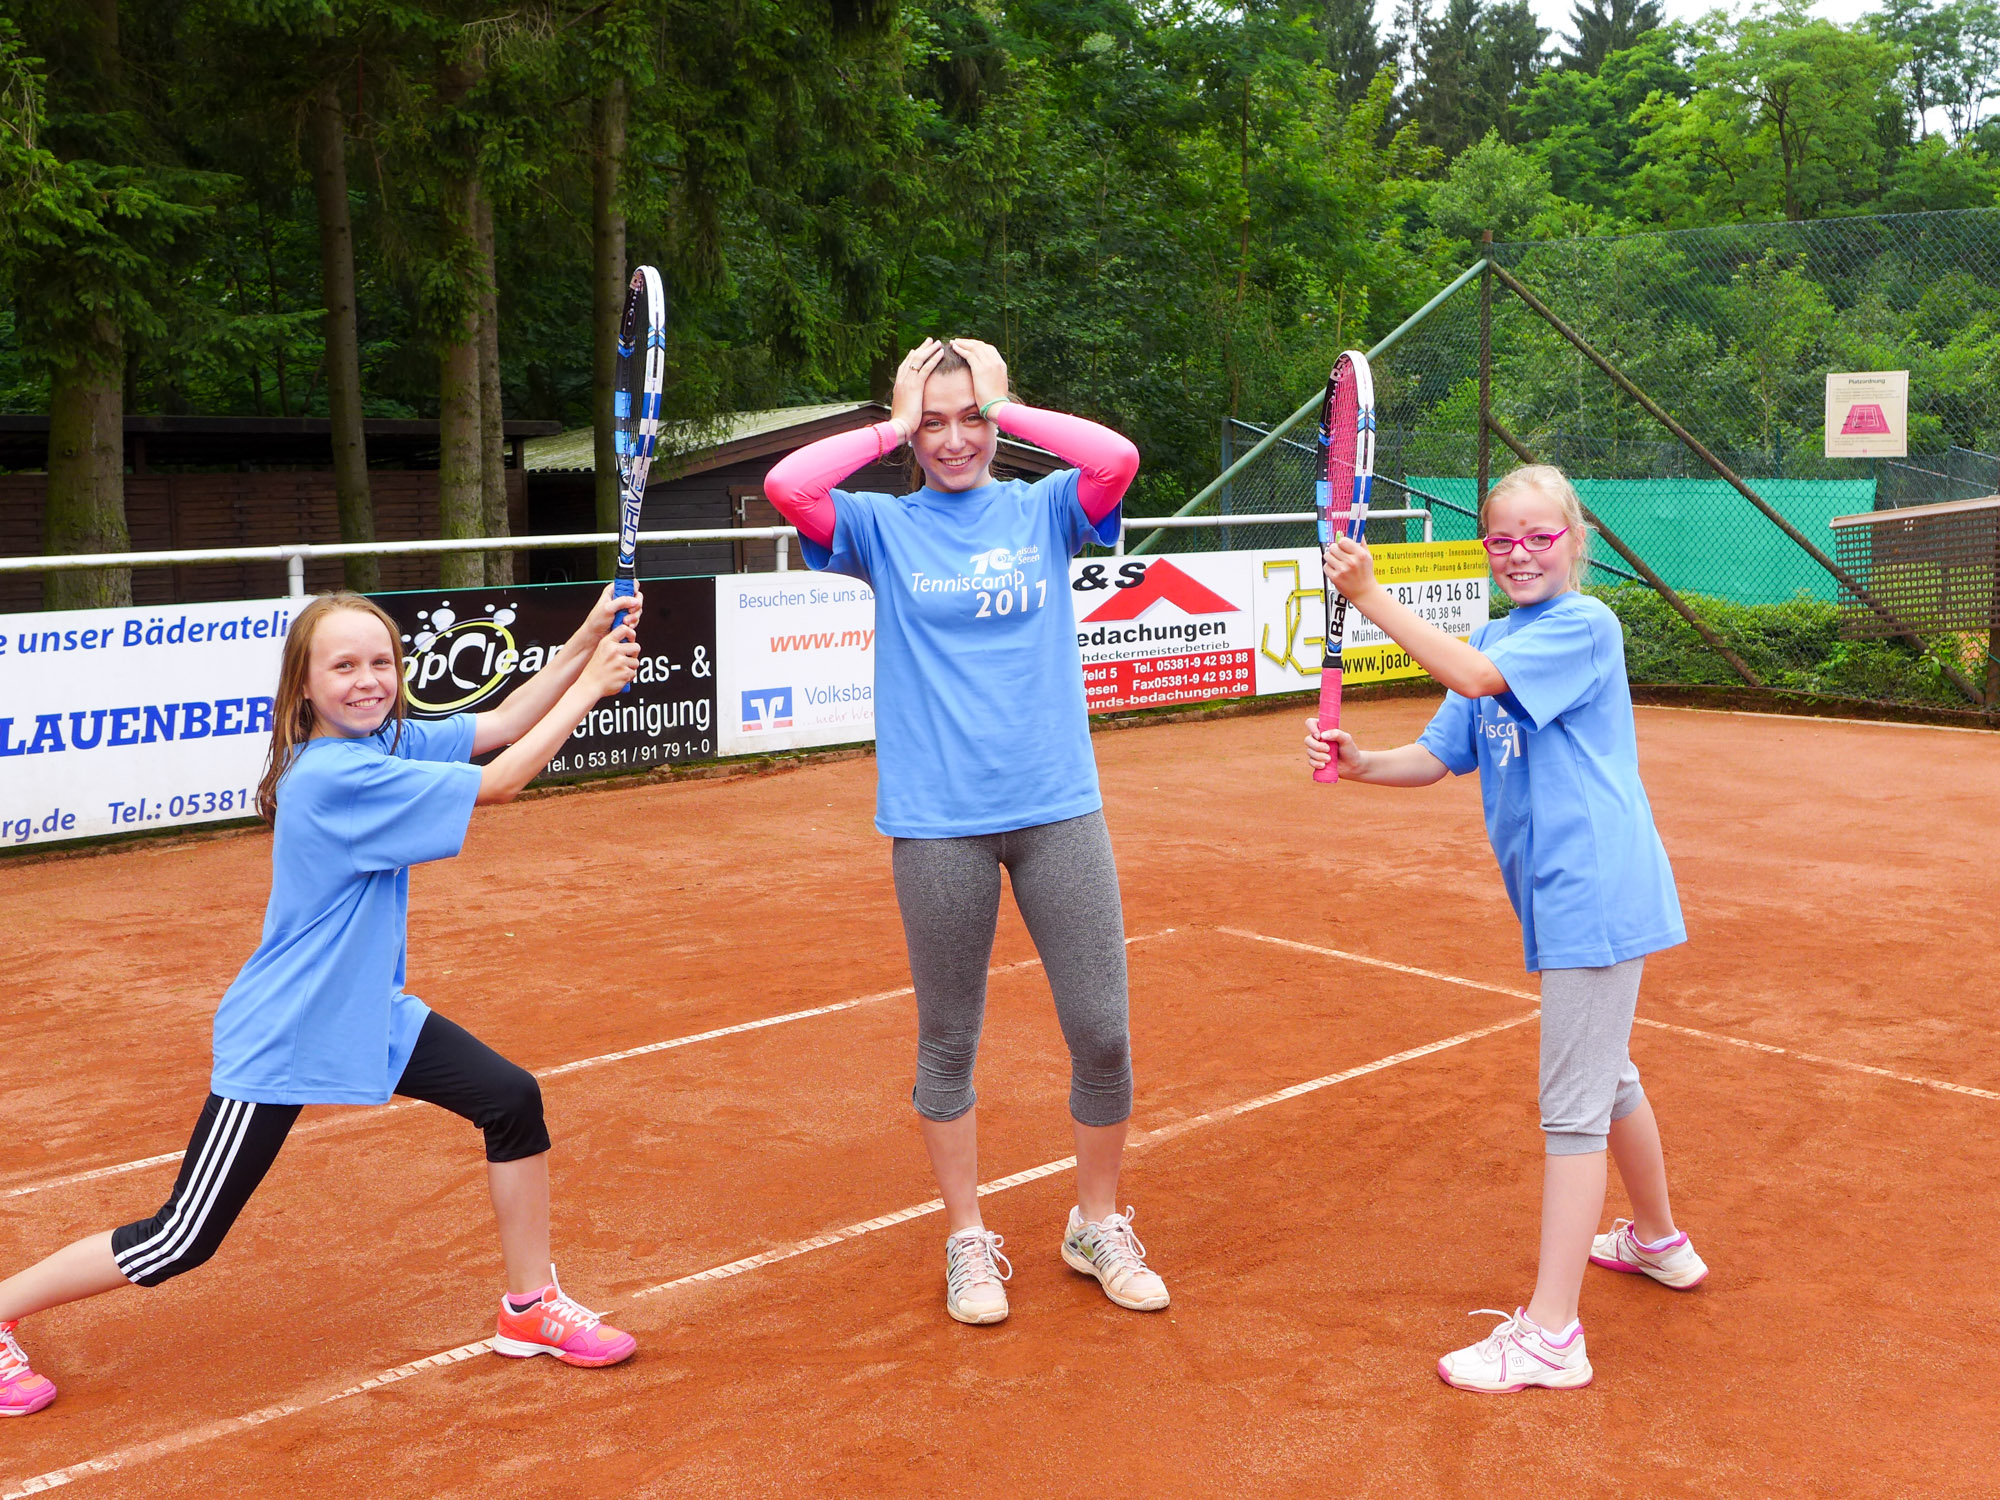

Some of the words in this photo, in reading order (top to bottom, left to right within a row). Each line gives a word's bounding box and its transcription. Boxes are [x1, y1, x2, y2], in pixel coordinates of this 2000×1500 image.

[1072, 564, 1109, 592] &
[1114, 562, 1147, 590] S
[1433, 563, 1456, 572] Planung
[1457, 562, 1462, 570] &
[911, 568, 1025, 593] Tenniscamp
[739, 590, 806, 609] Besuchen
[810, 588, 829, 605] Sie
[833, 588, 856, 603] uns
[859, 588, 875, 602] au
[975, 579, 1047, 618] 2017
[1398, 586, 1414, 606] 81
[1426, 584, 1442, 603] 49
[1447, 583, 1462, 601] 16
[1466, 581, 1481, 600] 81
[1330, 593, 1348, 638] Bab
[1426, 608, 1437, 621] 30
[1439, 607, 1449, 619] 38
[1451, 606, 1461, 618] 94
[18, 626, 114, 655] unser
[122, 610, 289, 648] Bäderateli
[770, 628, 875, 653] www.my
[1077, 621, 1227, 648] edachungen
[1352, 629, 1391, 643] Mühlenw
[1443, 622, 1471, 634] Seesen
[691, 645, 712, 679] &
[1082, 641, 1230, 663] hdeckermeisterbetrieb
[1133, 661, 1154, 674] Tel.
[1156, 657, 1201, 671] 05381-9
[1203, 655, 1217, 667] 42
[1219, 653, 1233, 665] 93
[1235, 652, 1249, 664] 88
[1342, 650, 1424, 676] www.joao-
[1083, 667, 1107, 681] feld
[1109, 667, 1118, 679] 5
[1203, 672, 1217, 683] 42
[1219, 670, 1233, 681] 93
[1235, 668, 1249, 680] 89
[804, 682, 872, 706] Volksba
[1087, 682, 1249, 709] unds-bedachungen.de
[0, 696, 277, 758] LAUENBER
[568, 698, 711, 738] ereinigung
[574, 753, 584, 770] 0
[588, 750, 607, 768] 53
[610, 748, 627, 765] 81
[632, 746, 638, 763] /
[641, 744, 657, 761] 91
[663, 742, 681, 758] 79
[701, 738, 710, 754] 0
[2, 808, 77, 843] rg.de
[108, 799, 162, 826] Tel.:
[169, 788, 258, 818] 05381-
